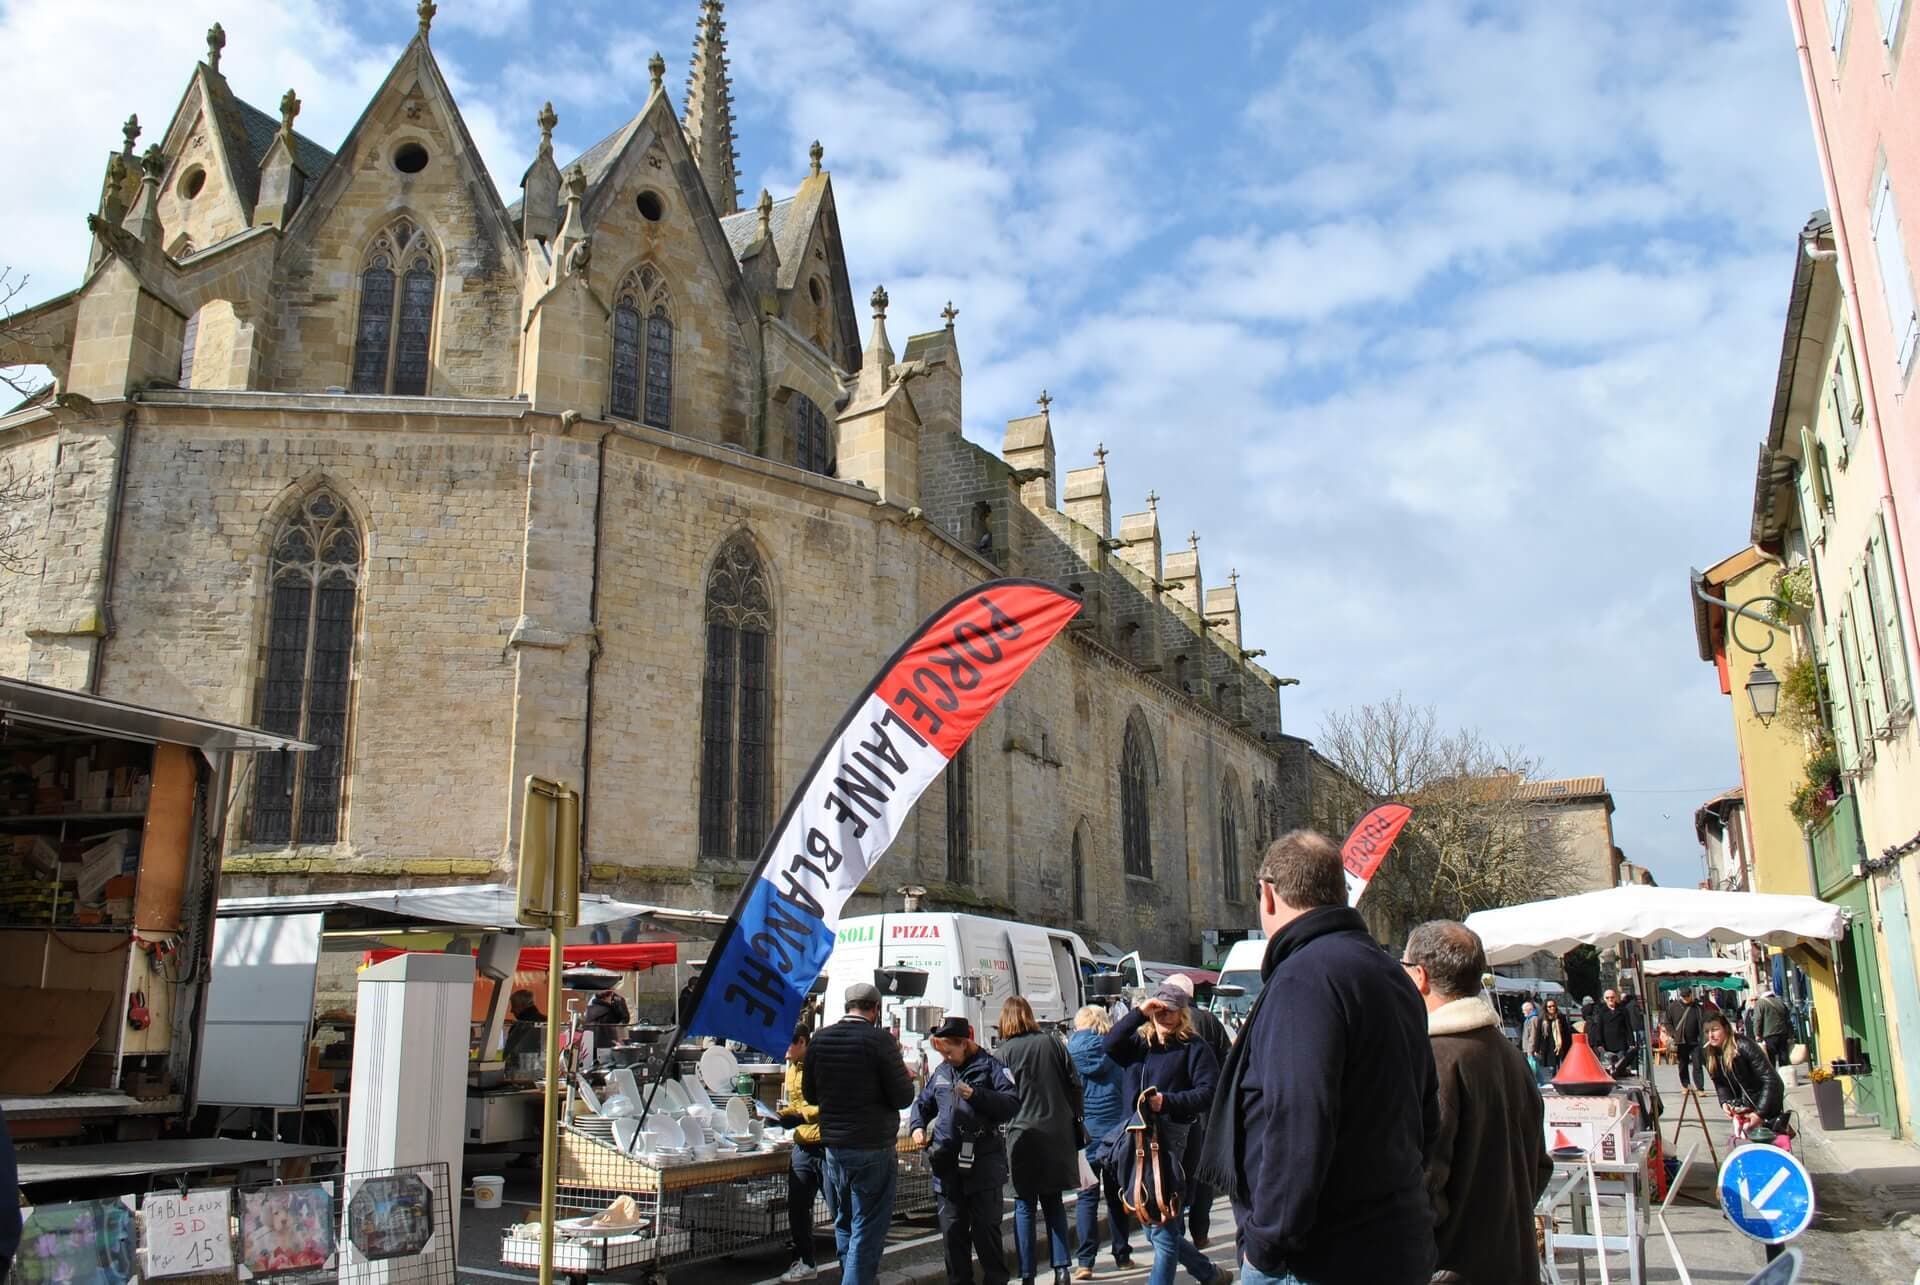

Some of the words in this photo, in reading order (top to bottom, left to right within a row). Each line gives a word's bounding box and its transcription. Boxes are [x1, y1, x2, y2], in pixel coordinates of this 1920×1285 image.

[823, 595, 1025, 840] PORCELAINE
[723, 826, 844, 1029] BLANCHE
[838, 925, 875, 945] SOLI
[892, 924, 941, 939] PIZZA
[147, 1200, 222, 1220] TABLEAUX
